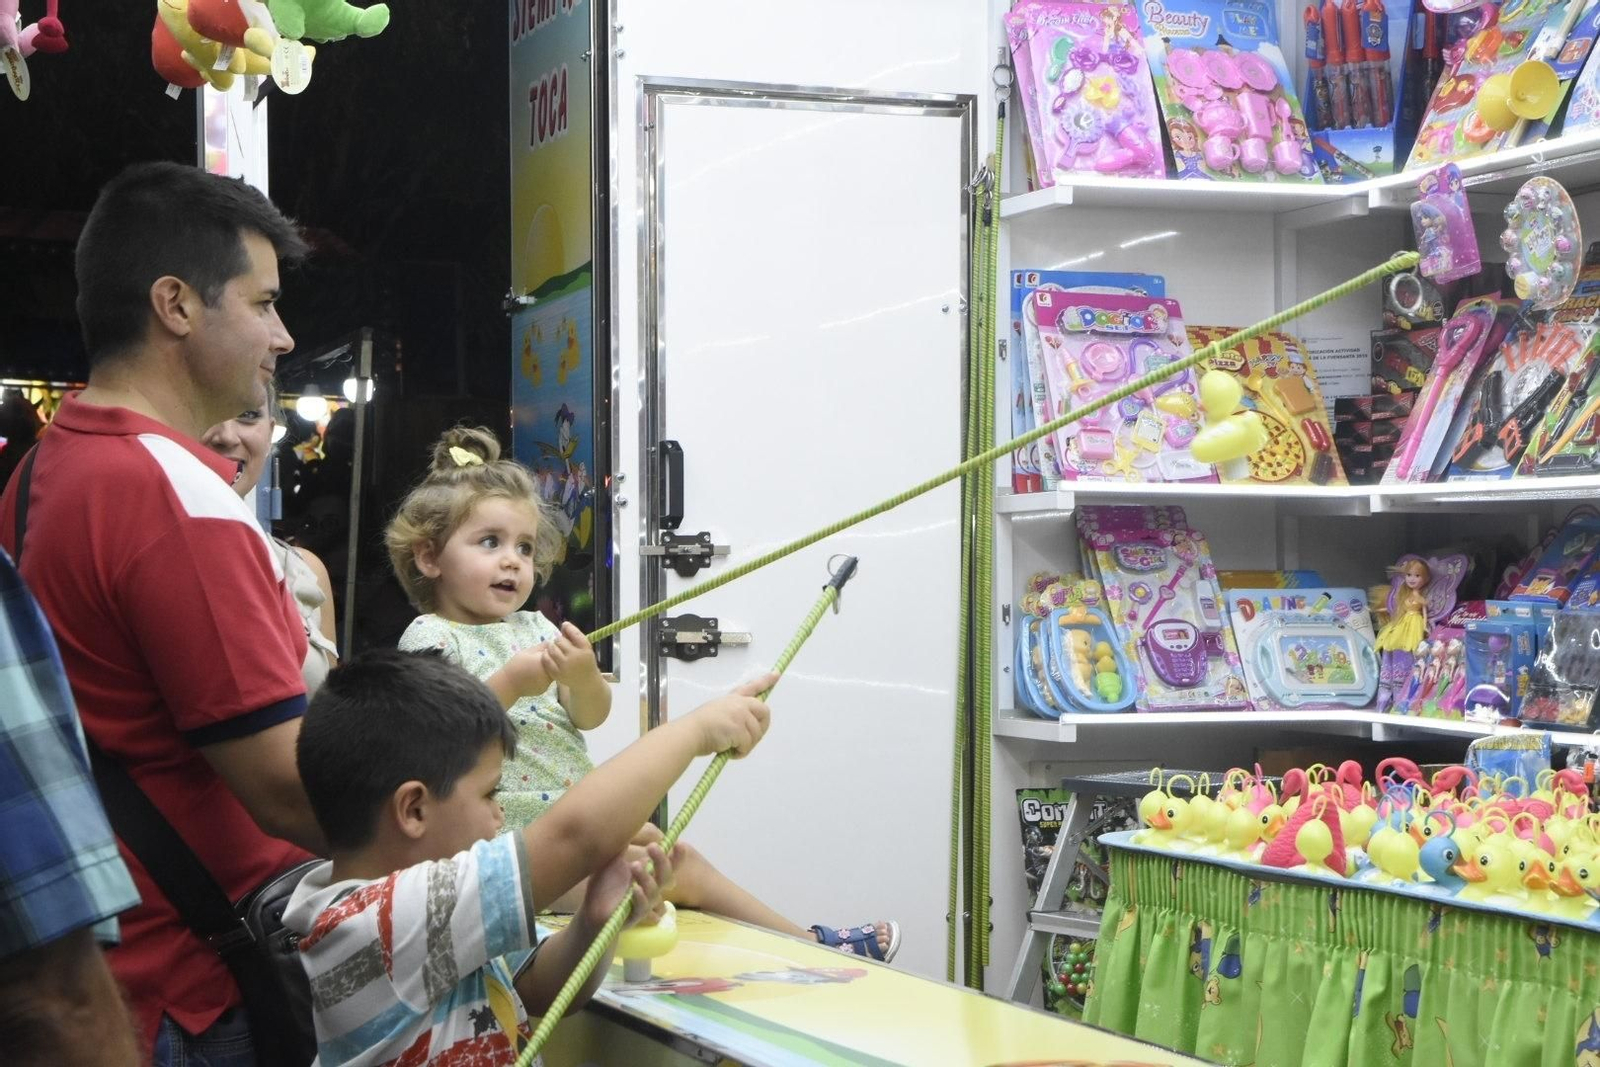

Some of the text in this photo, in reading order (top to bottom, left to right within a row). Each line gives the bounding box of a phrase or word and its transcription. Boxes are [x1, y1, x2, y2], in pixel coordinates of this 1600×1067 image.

[1144, 2, 1208, 35] Beauty
[529, 68, 568, 147] TOCA
[1078, 306, 1158, 331] DOCTOR
[1236, 595, 1306, 622] DRAWING
[1022, 799, 1106, 822] COMT
